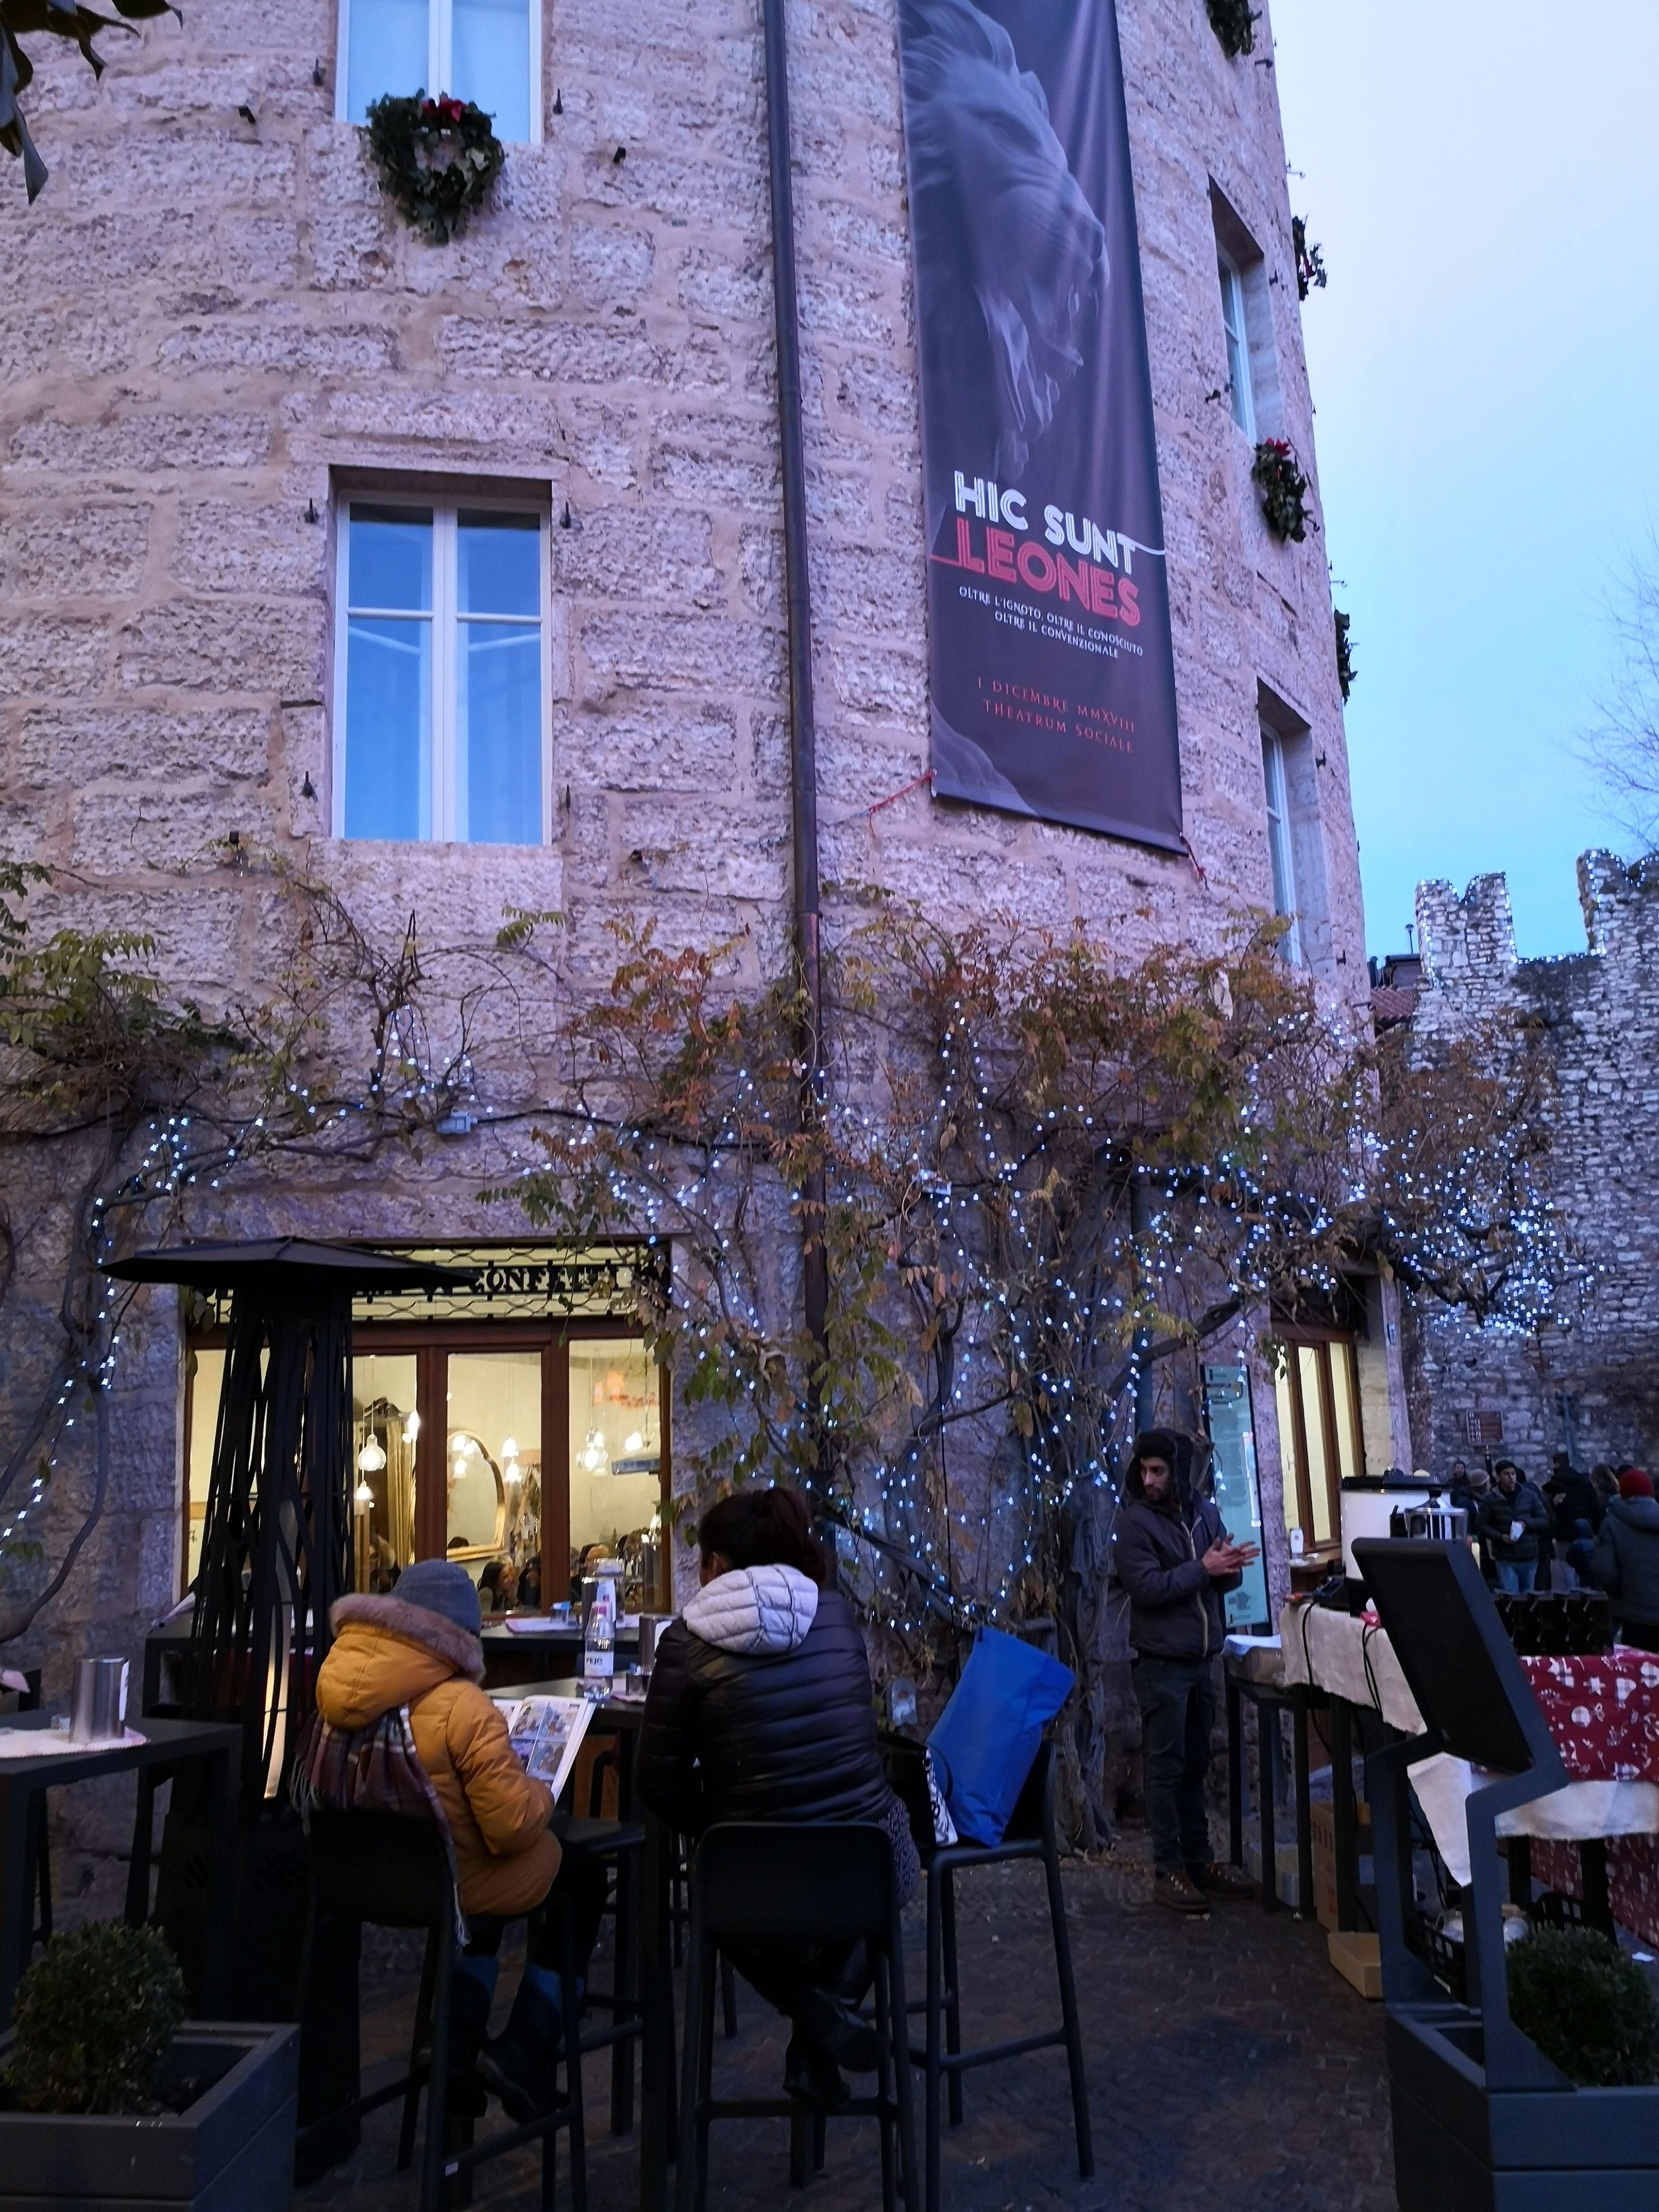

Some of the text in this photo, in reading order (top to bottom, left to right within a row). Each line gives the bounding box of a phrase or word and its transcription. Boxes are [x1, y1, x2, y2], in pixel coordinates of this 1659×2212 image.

[954, 470, 1136, 575] HIC SUNT
[955, 516, 1141, 627] LEONES
[959, 585, 1143, 657] OLTRE L'IGNOTO, OLTRE IL CONOSCIUTO
[995, 610, 1119, 659] OLTRE IL CONVENZIONALE
[983, 698, 1133, 753] THEATRUM SOCIALE
[993, 679, 1068, 714] DICEMBRE
[1078, 704, 1135, 733] MMXVIII
